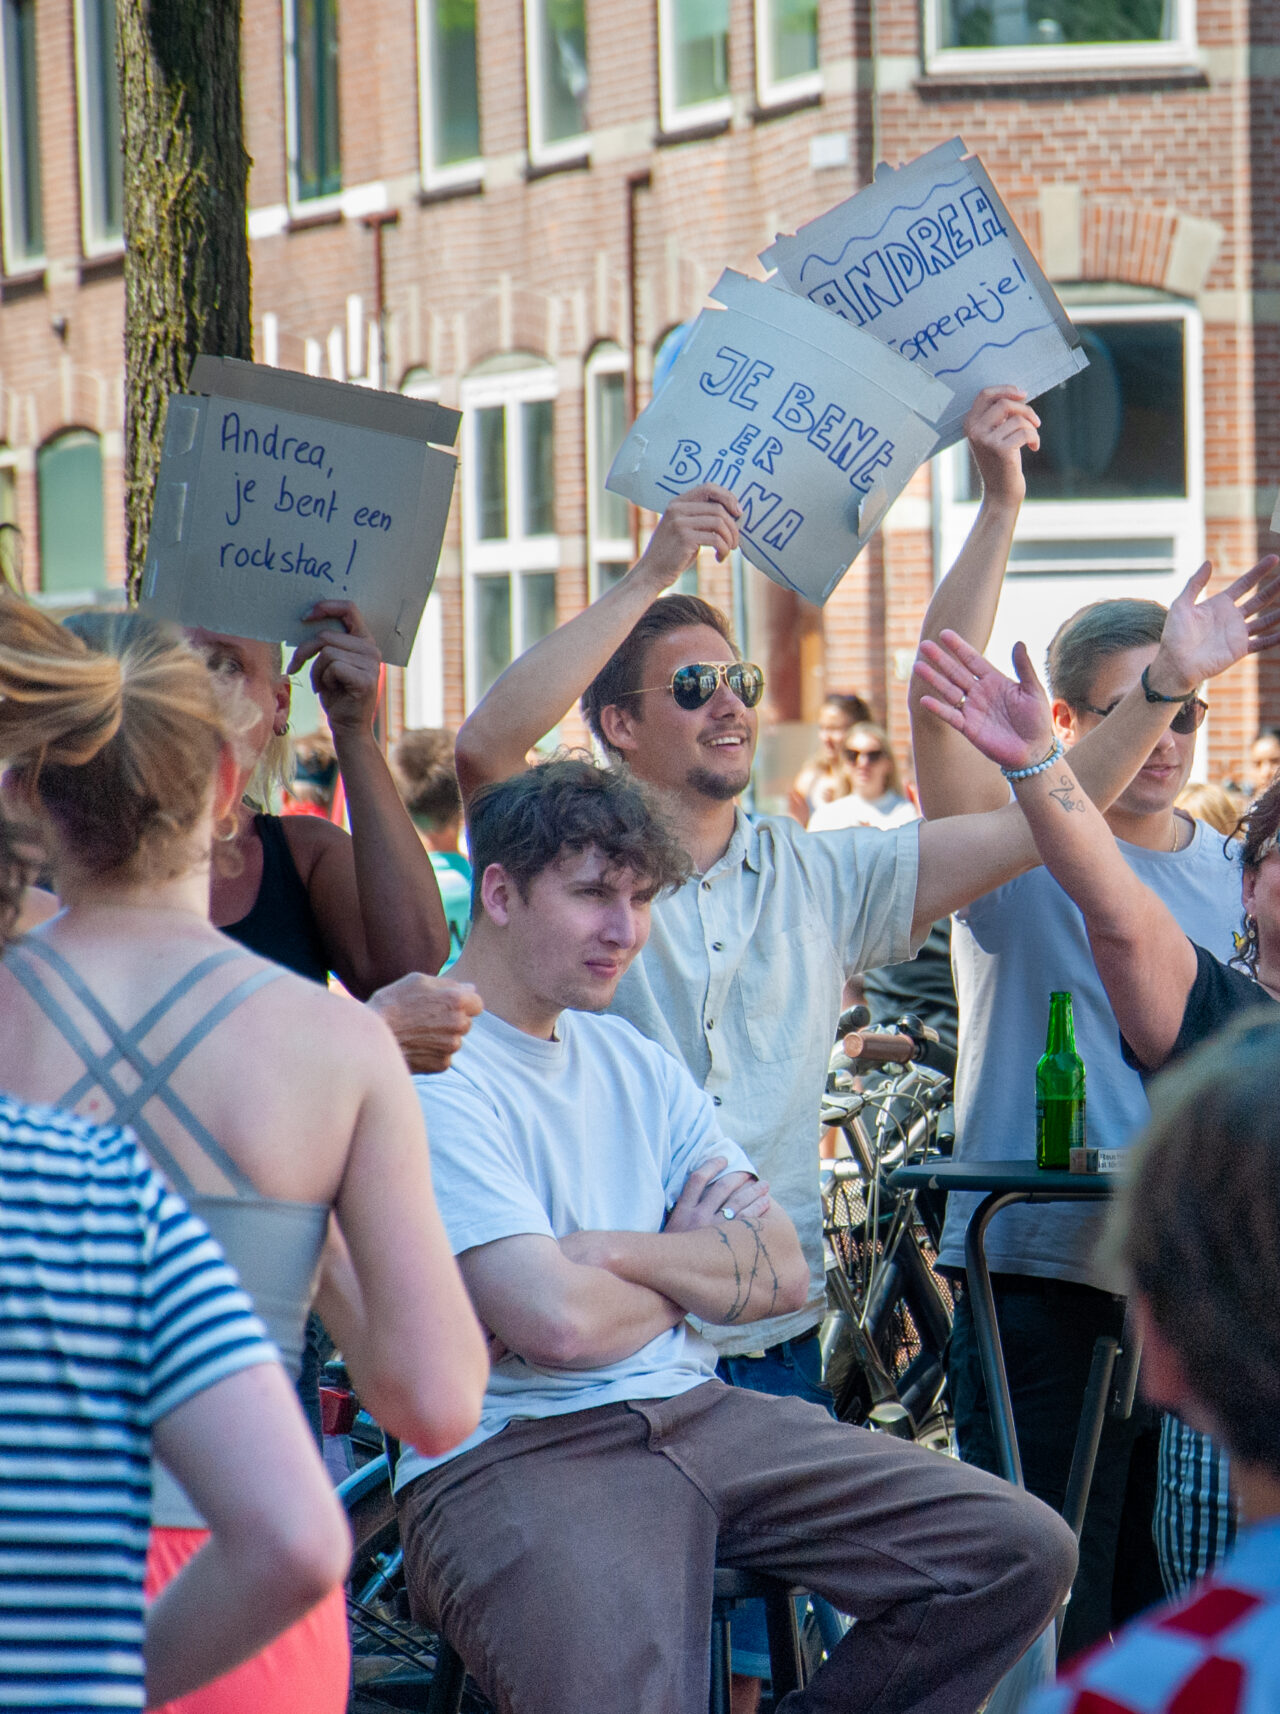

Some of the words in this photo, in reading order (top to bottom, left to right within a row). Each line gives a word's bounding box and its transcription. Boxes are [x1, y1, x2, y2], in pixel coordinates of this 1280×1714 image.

[808, 186, 1007, 327] ANDREA
[887, 258, 1033, 361] oppertje!
[699, 346, 775, 411] JE
[221, 412, 334, 478] Andrea,
[729, 423, 783, 475] ER
[225, 472, 256, 526] je
[274, 475, 338, 523] bent
[353, 507, 392, 531] een
[220, 538, 357, 592] rockstar!
